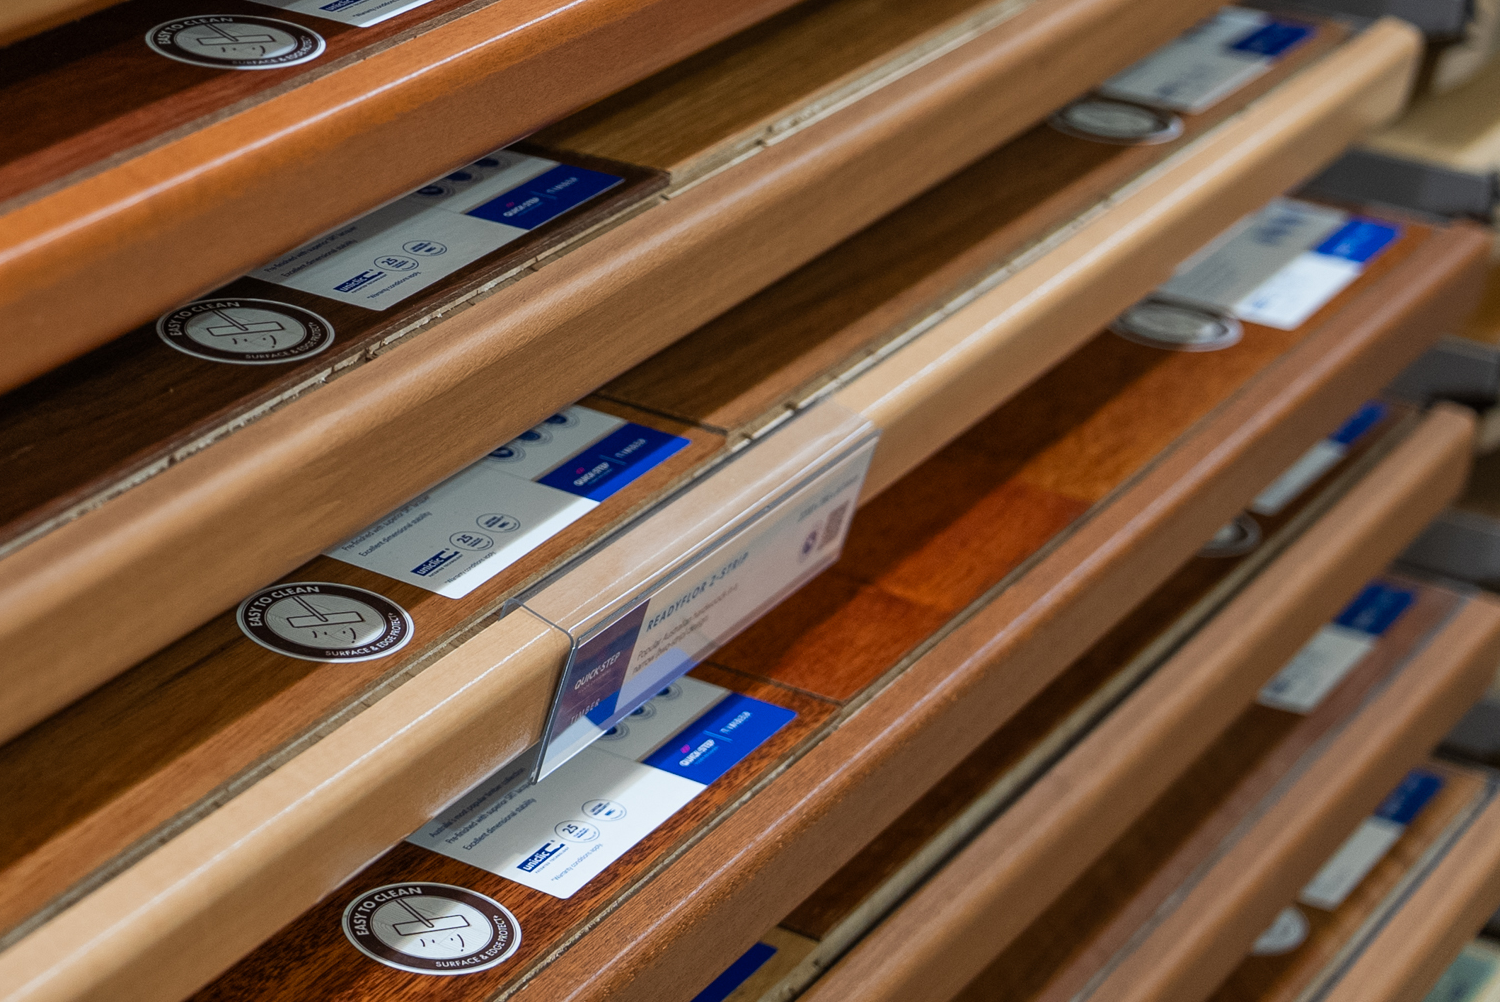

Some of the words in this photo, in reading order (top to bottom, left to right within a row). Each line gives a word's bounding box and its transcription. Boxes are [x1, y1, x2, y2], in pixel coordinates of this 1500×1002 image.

[183, 16, 234, 27] CLEAN
[165, 22, 184, 36] TO
[158, 31, 173, 45] EASY
[193, 301, 241, 313] CLEAN
[173, 311, 192, 324] TO
[167, 323, 182, 336] EASY
[457, 534, 474, 544] 25
[271, 586, 320, 599] CLEAN
[254, 596, 273, 609] TO
[646, 581, 708, 632] READYFLOR
[248, 607, 263, 627] EASY
[325, 647, 370, 657] SURFACE
[376, 634, 396, 649] EDGE
[570, 698, 601, 724] TIMBER
[562, 823, 579, 834] 25
[462, 831, 489, 851] Excellent
[522, 850, 551, 871] uniclic
[373, 887, 423, 903] CLEAN
[358, 900, 376, 914] TO
[353, 913, 370, 936] EASY
[435, 956, 480, 968] SURFACE
[485, 941, 505, 958] EDGE
